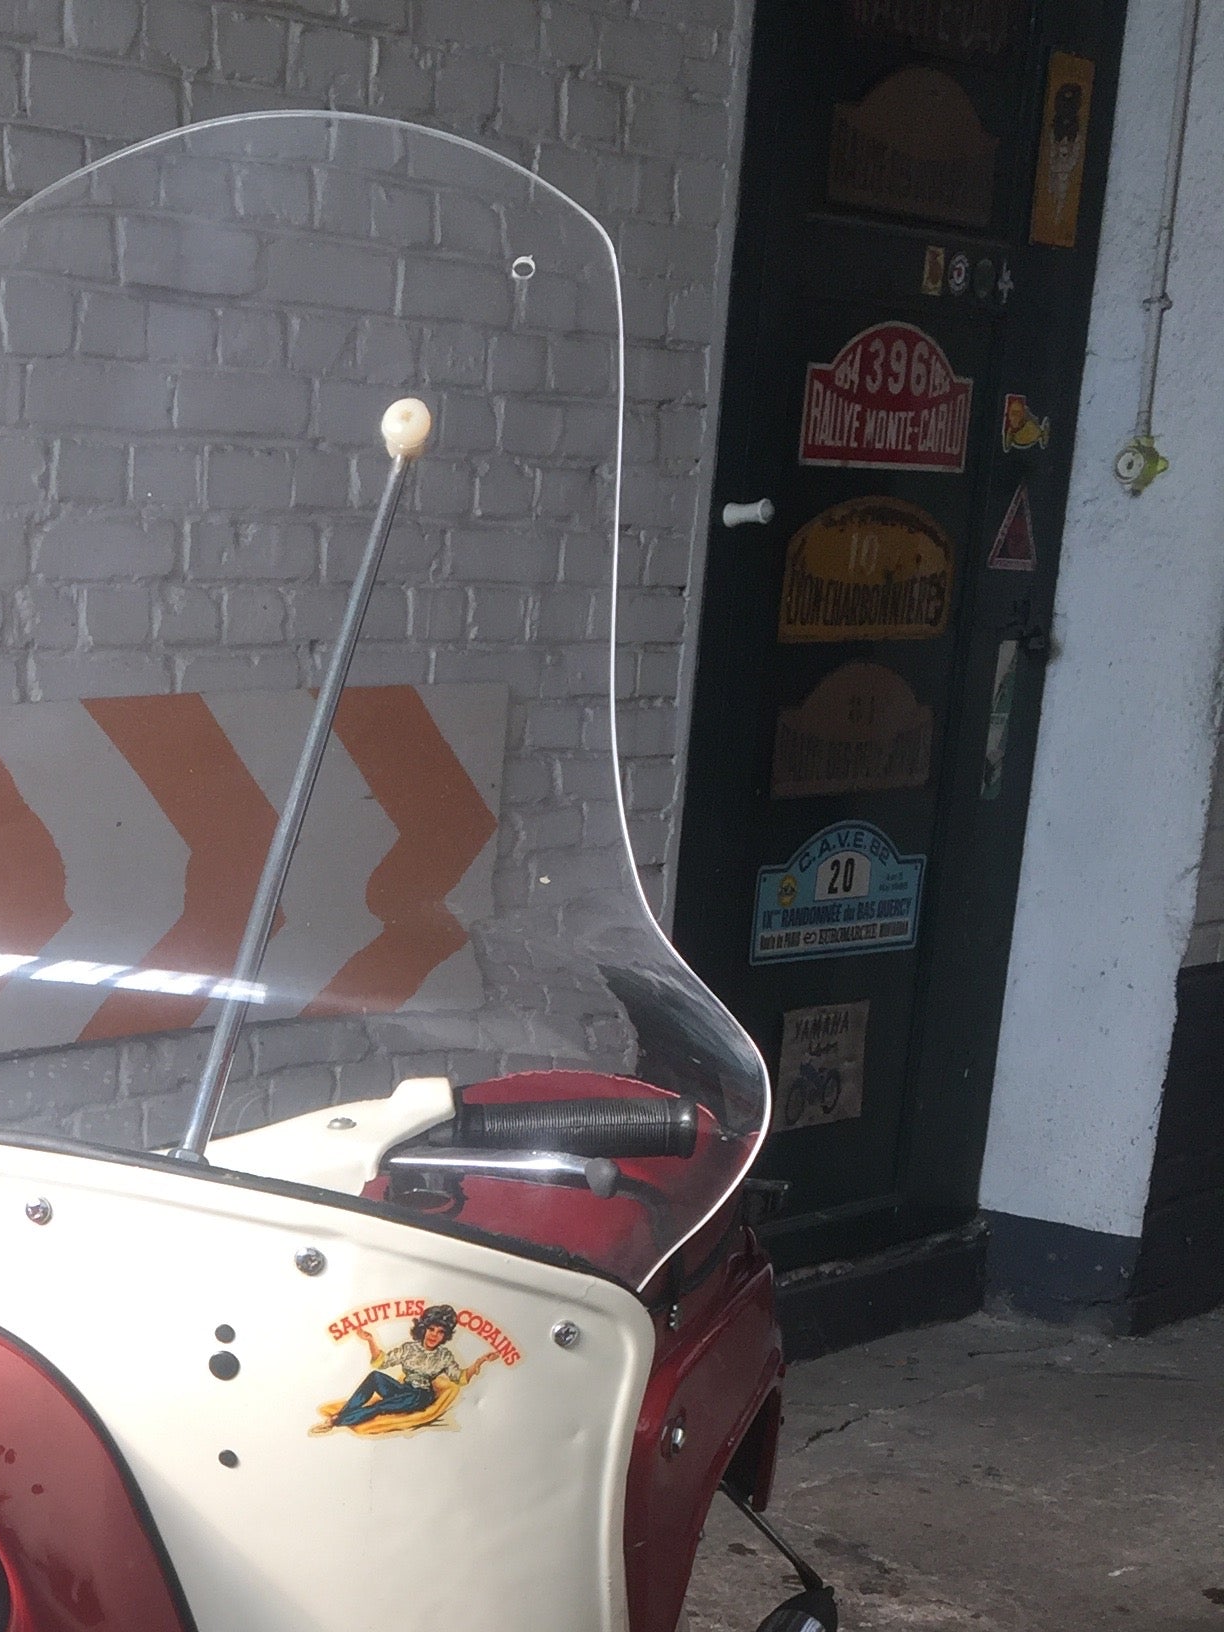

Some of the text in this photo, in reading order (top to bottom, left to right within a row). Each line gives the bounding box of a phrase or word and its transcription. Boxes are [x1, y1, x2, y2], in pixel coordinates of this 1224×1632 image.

[865, 337, 929, 397] 396
[808, 379, 966, 455] RALLYE MONTE-CARLO
[827, 857, 856, 895] 20
[843, 904, 856, 923] du
[857, 901, 876, 921] BAS
[877, 898, 913, 919] QUERCY
[796, 1010, 850, 1042] YAMAHA
[328, 1299, 521, 1367] SALUT LES COPAINS
